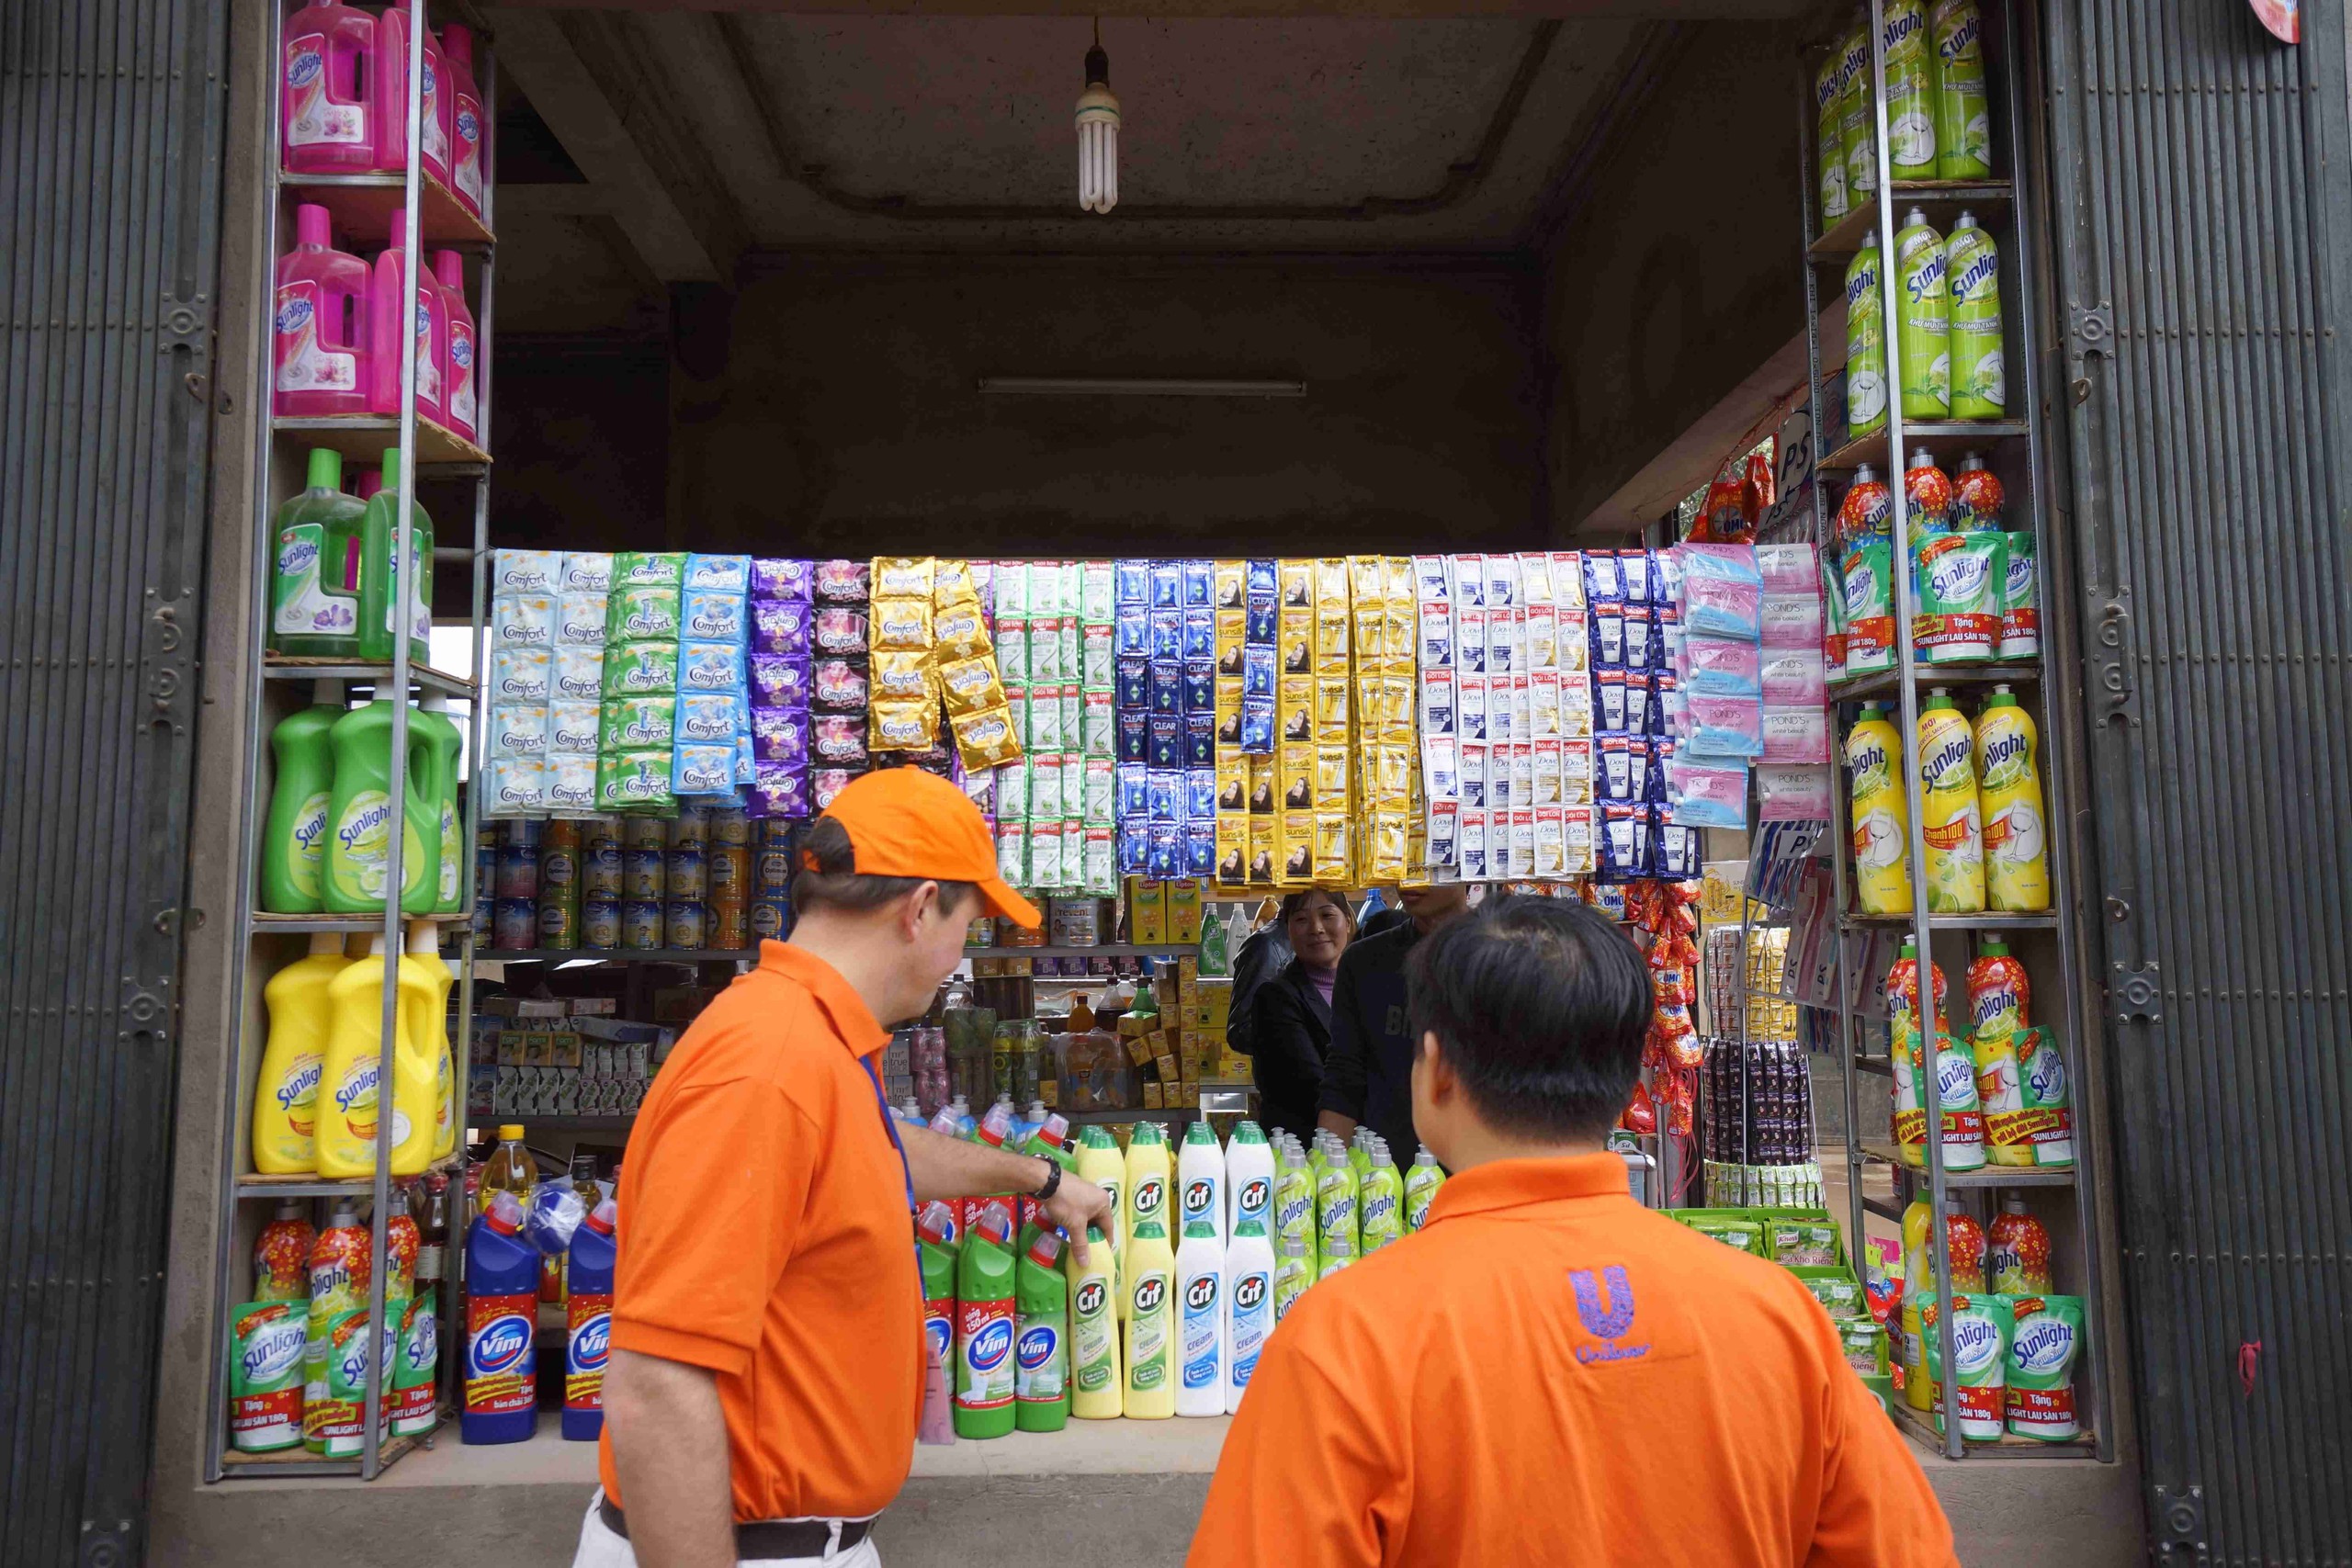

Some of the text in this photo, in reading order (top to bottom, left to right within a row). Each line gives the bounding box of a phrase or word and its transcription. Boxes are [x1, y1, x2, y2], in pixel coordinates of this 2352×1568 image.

[1883, 11, 1923, 53] nlight
[1907, 254, 1947, 303] Sunlig
[1864, 496, 1891, 530] Sunli
[278, 543, 319, 576] Sunlight
[505, 570, 547, 589] Comfort
[569, 570, 609, 589] Comfort
[632, 567, 673, 583] Comfort
[885, 574, 922, 586] Comfort
[1931, 557, 1990, 600] Sunlight
[565, 623, 605, 642] Comfort
[628, 615, 670, 635] Comfort
[693, 619, 736, 637] Comfort
[884, 621, 921, 636] Comfort
[1602, 624, 1620, 632] Dove
[1953, 617, 1973, 629] Tặng
[503, 625, 547, 643] Comfort
[1950, 634, 1962, 644] LAU
[1963, 631, 1977, 643] SÀN
[1188, 664, 1211, 672] CLEAR
[1769, 660, 1804, 670] POND'S
[503, 679, 547, 697] Comfort
[560, 677, 602, 696] Comfort
[628, 671, 669, 690] Comfort
[690, 669, 732, 689] Comfort
[883, 671, 921, 686] Comfort
[1123, 714, 1146, 722] CLEAR
[1189, 719, 1212, 728] CLEAR
[1709, 709, 1741, 719] POND'S
[1771, 716, 1806, 726] POND'S
[628, 725, 669, 743] Comfort
[687, 719, 730, 738] Comfort
[883, 723, 921, 738] Comfort
[1153, 722, 1176, 730] CLEAR
[502, 732, 546, 751] Comfort
[556, 730, 598, 751] Comfort
[1609, 759, 1627, 767] Dove
[1849, 748, 1884, 778] nlight
[1922, 735, 1973, 794] Sunligh
[627, 778, 669, 798] Comfort
[684, 771, 727, 790] Comfort
[1778, 774, 1811, 784] POND'S
[501, 786, 543, 804] Comfort
[552, 784, 595, 804] Comfort
[296, 812, 326, 851] Sunli
[1318, 821, 1344, 829] sunsilk
[1379, 821, 1404, 829] sunsilk
[1139, 881, 1159, 889] Lipton
[1175, 881, 1195, 889] Lipton
[1604, 896, 1623, 906] OMO
[1136, 1182, 1160, 1213] Cif
[1186, 1179, 1210, 1210] Cif
[1241, 1179, 1266, 1210] Cif
[1078, 1280, 1102, 1312] Cif
[1135, 1278, 1162, 1309] Cif
[1187, 1277, 1214, 1307] Cif
[1237, 1276, 1264, 1306] Cif
[1568, 1264, 1634, 1340] U
[481, 1334, 523, 1356] Vim
[976, 1337, 1008, 1356] Vim
[1020, 1342, 1048, 1355] Vim
[2013, 1322, 2073, 1370] Sunlight
[2029, 1393, 2052, 1408] Tặng
[1973, 1407, 1992, 1422] 180g
[2028, 1408, 2042, 1420] LAU
[2042, 1407, 2058, 1421] SÀN
